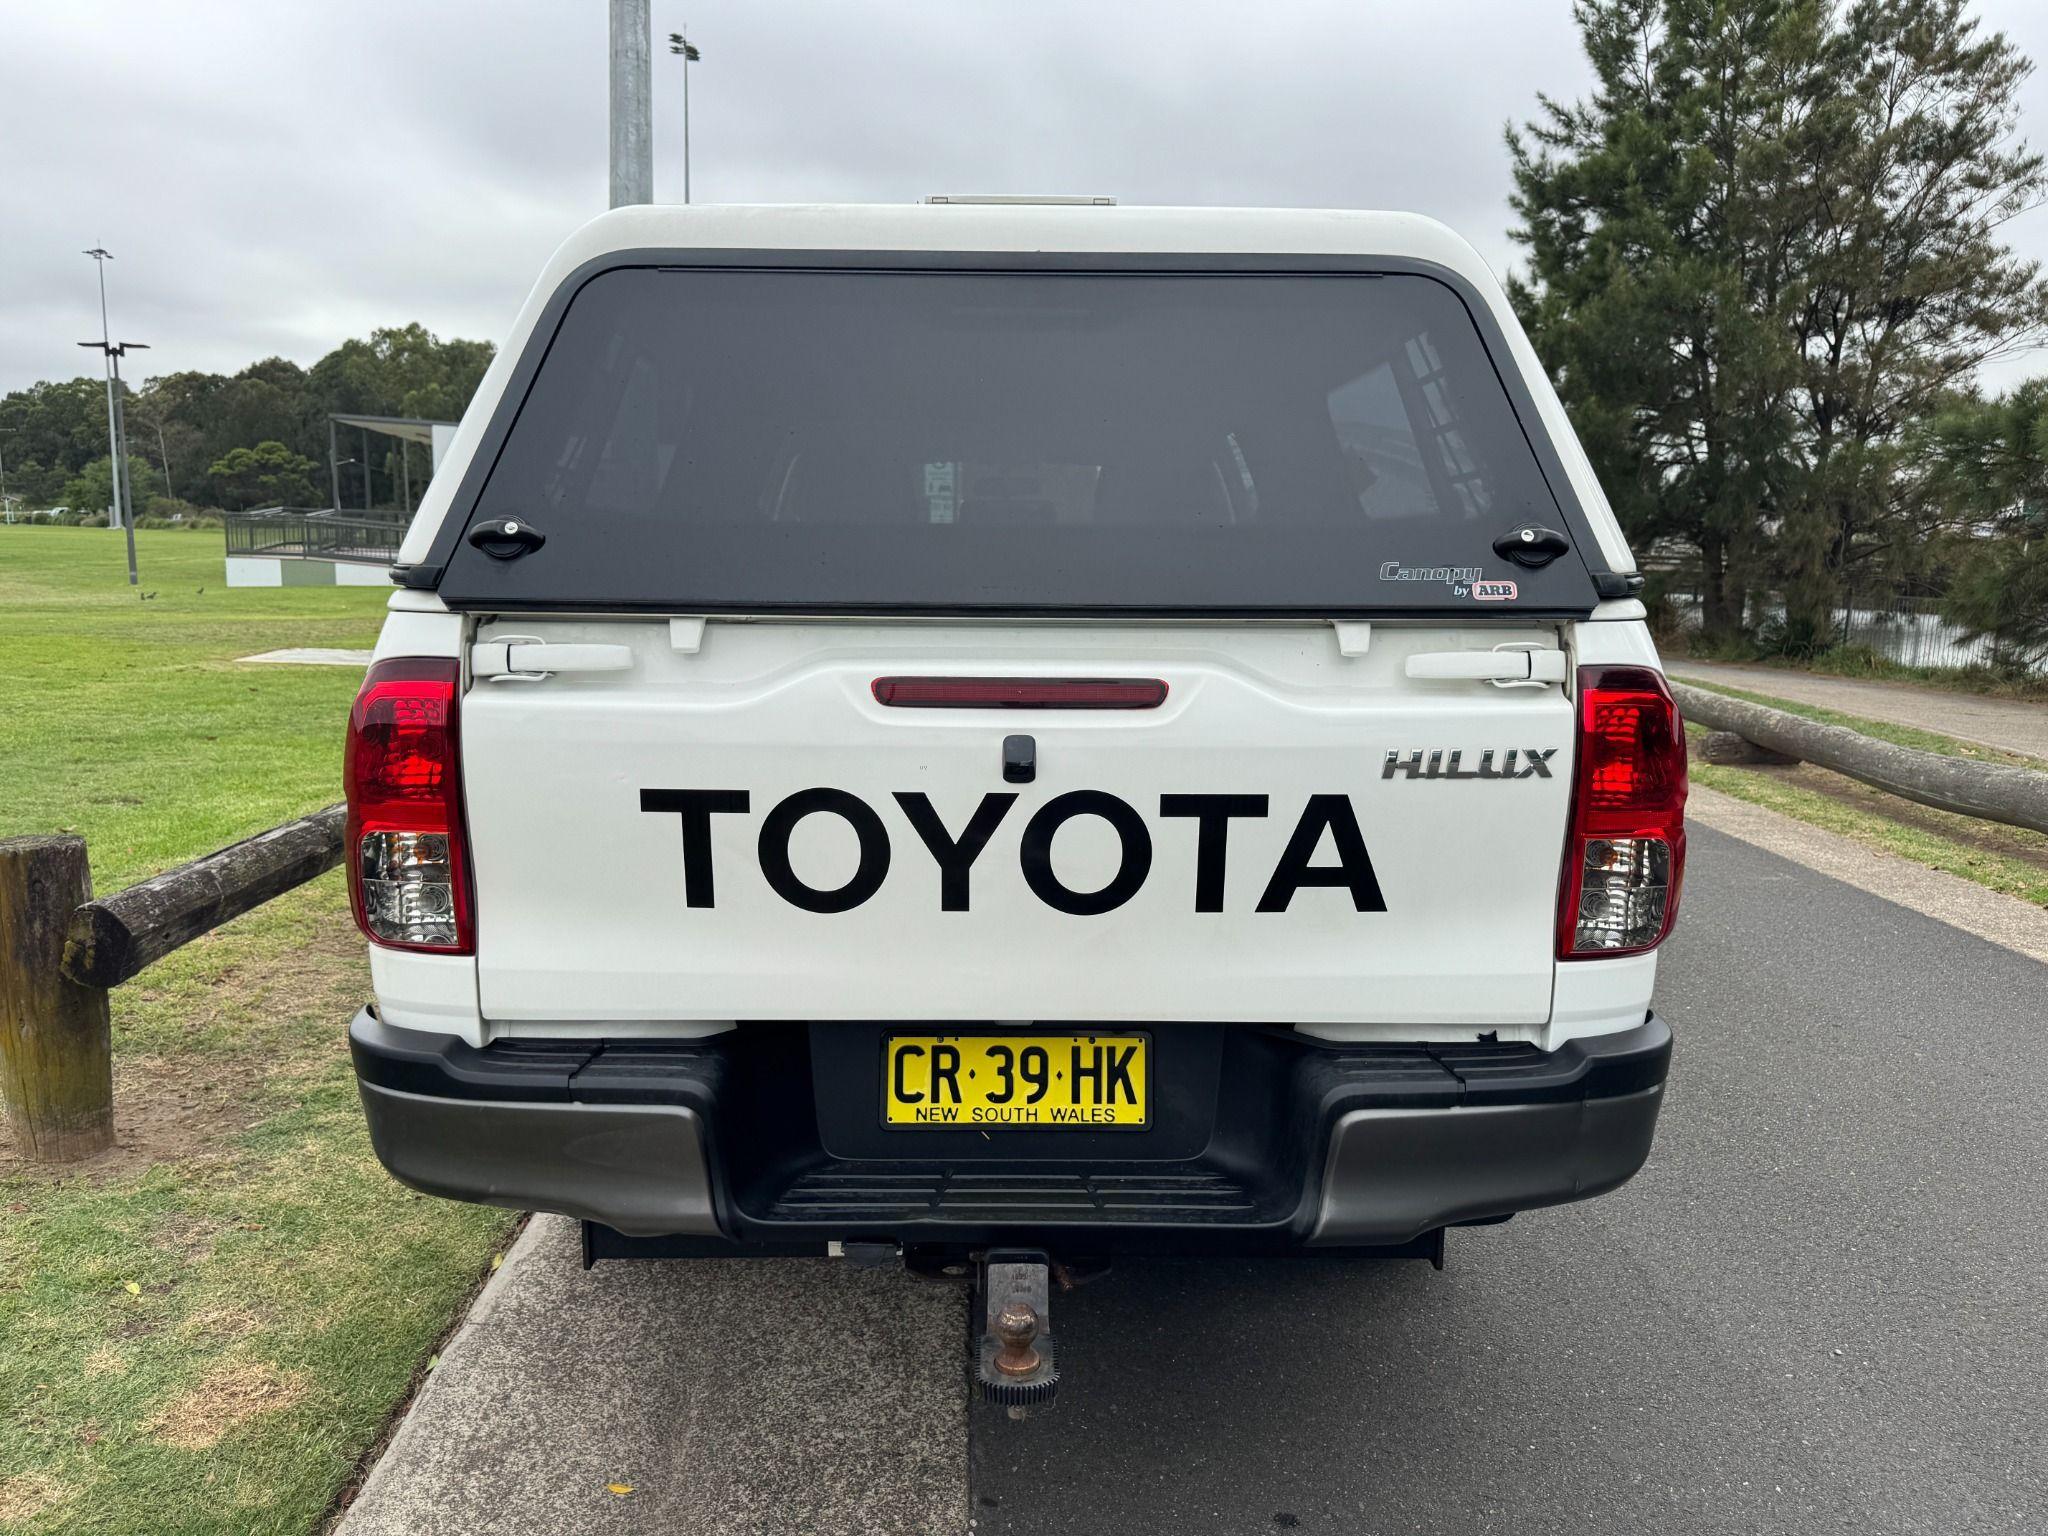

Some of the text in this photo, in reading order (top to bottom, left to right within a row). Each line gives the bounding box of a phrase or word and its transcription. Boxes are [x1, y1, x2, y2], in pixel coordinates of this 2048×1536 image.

[1380, 561, 1482, 585] Canopy
[1453, 584, 1513, 598] by ARB
[1381, 748, 1559, 780] HILUX
[640, 786, 1388, 916] TOYOTA
[915, 1107, 1116, 1123] NEW SOUTH WALES
